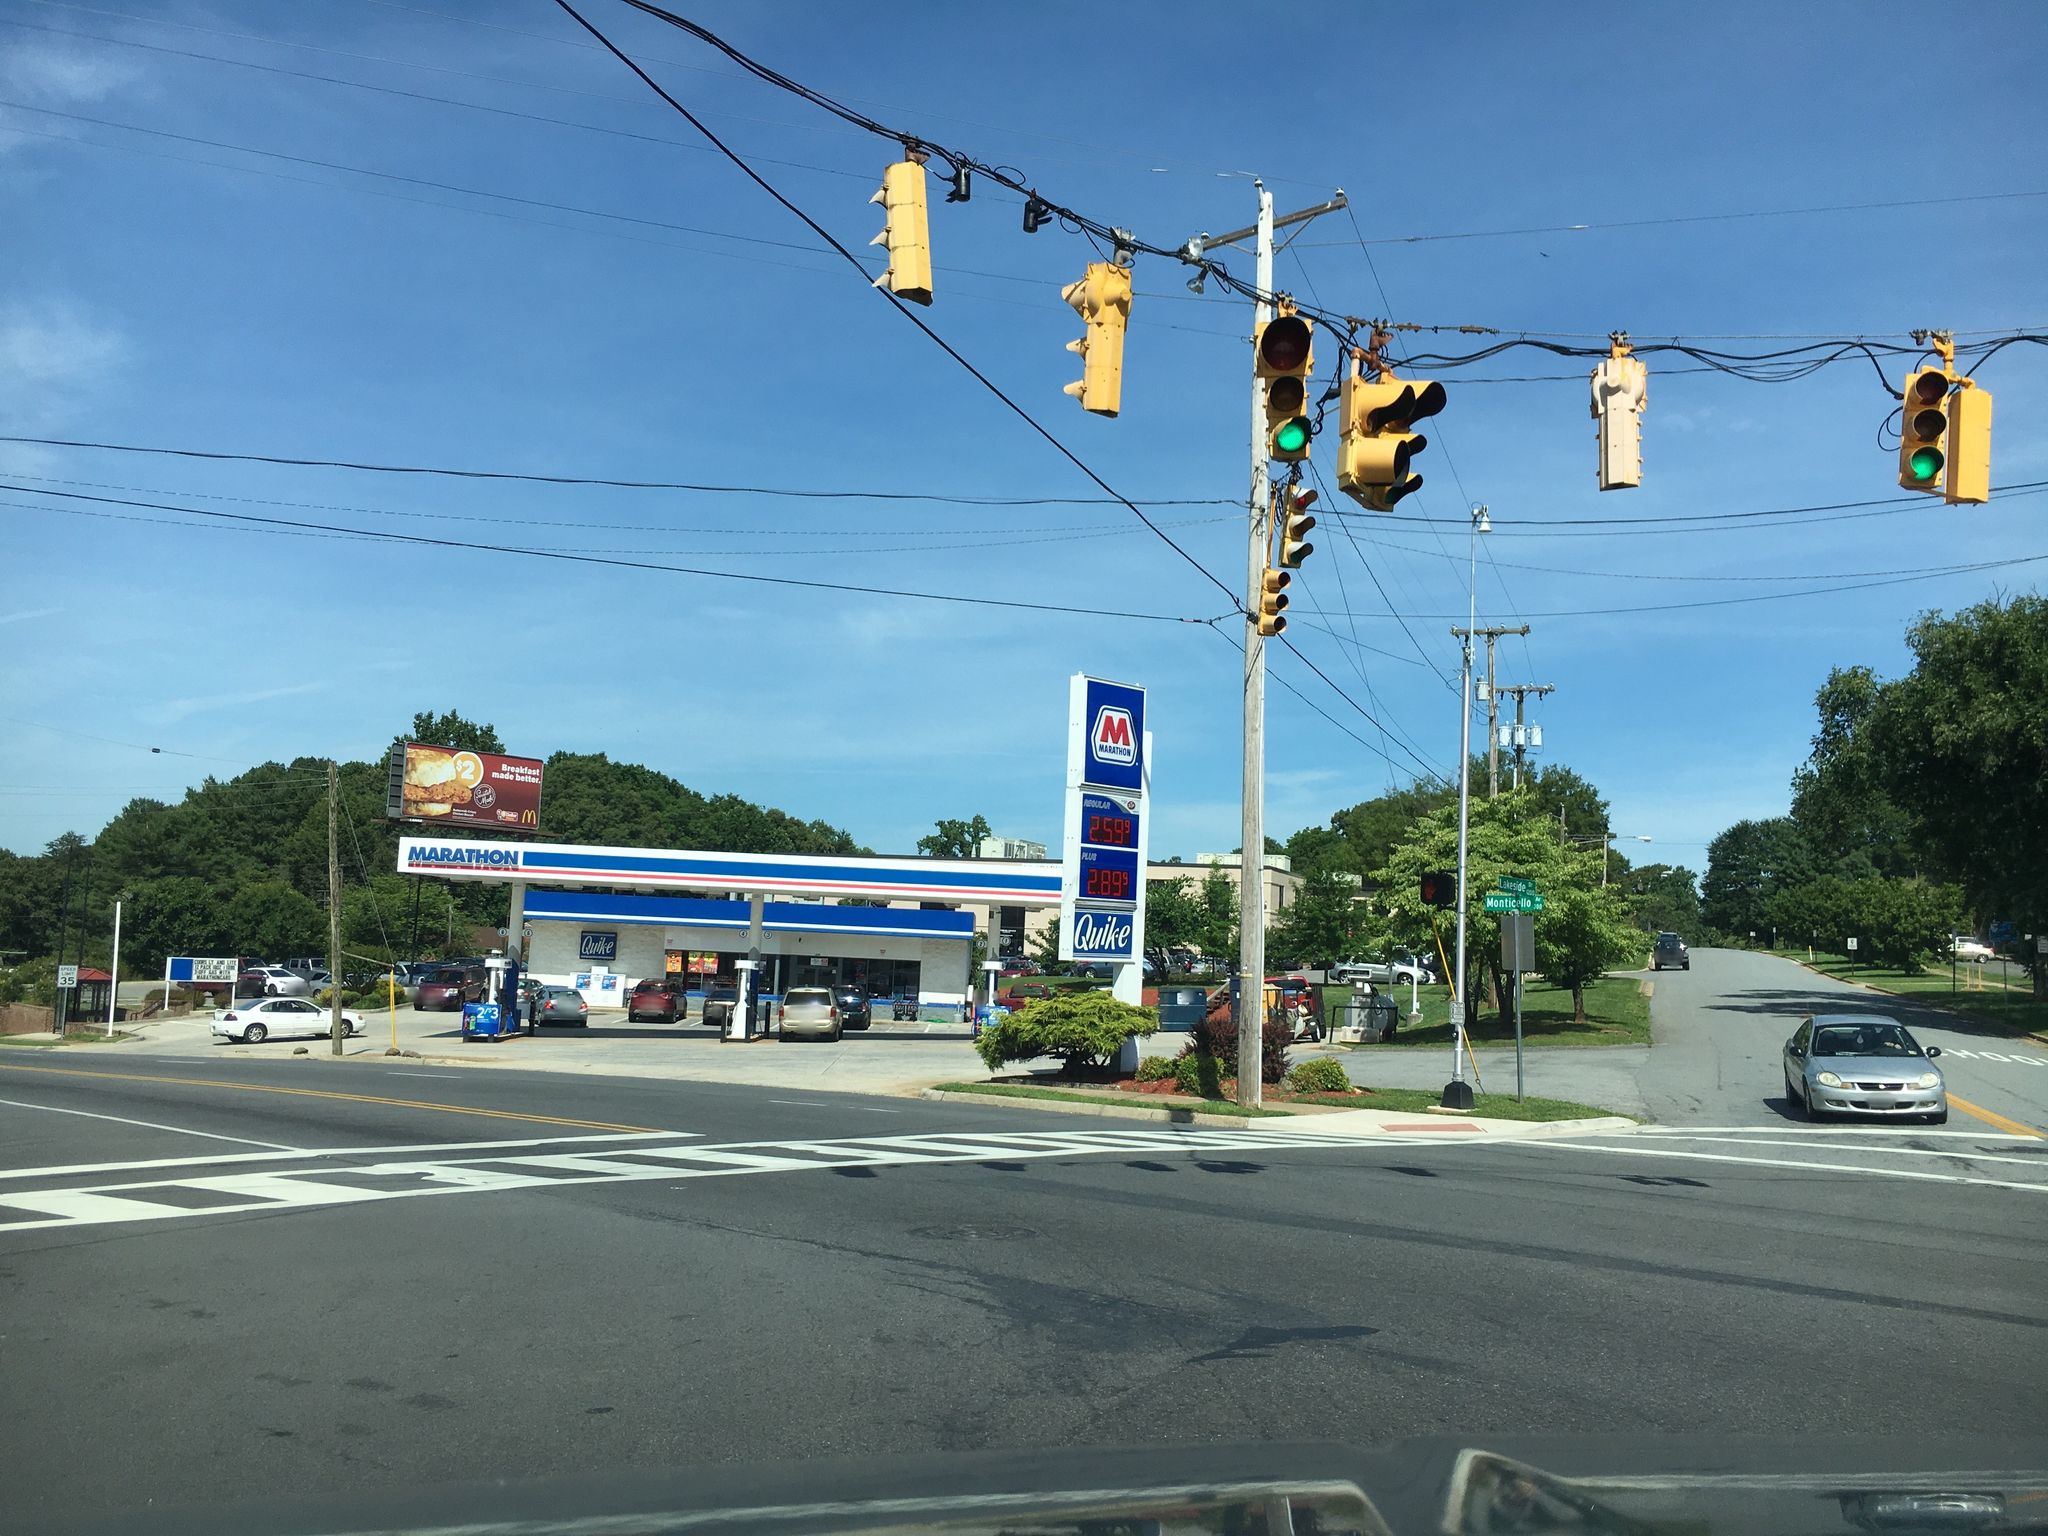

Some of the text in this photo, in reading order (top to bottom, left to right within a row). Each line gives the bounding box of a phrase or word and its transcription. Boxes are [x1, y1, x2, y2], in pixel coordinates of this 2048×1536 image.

[1098, 744, 1131, 757] MARATHON
[456, 760, 475, 780] $2
[501, 763, 540, 776] Breakfast
[491, 771, 541, 784] made better.
[1083, 798, 1111, 810] REGULAR
[408, 846, 519, 865] MARATHON
[1081, 851, 1098, 861] PLUS
[1500, 879, 1526, 892] Lakeside
[1486, 897, 1532, 908] Monticello
[60, 976, 75, 986] 35
